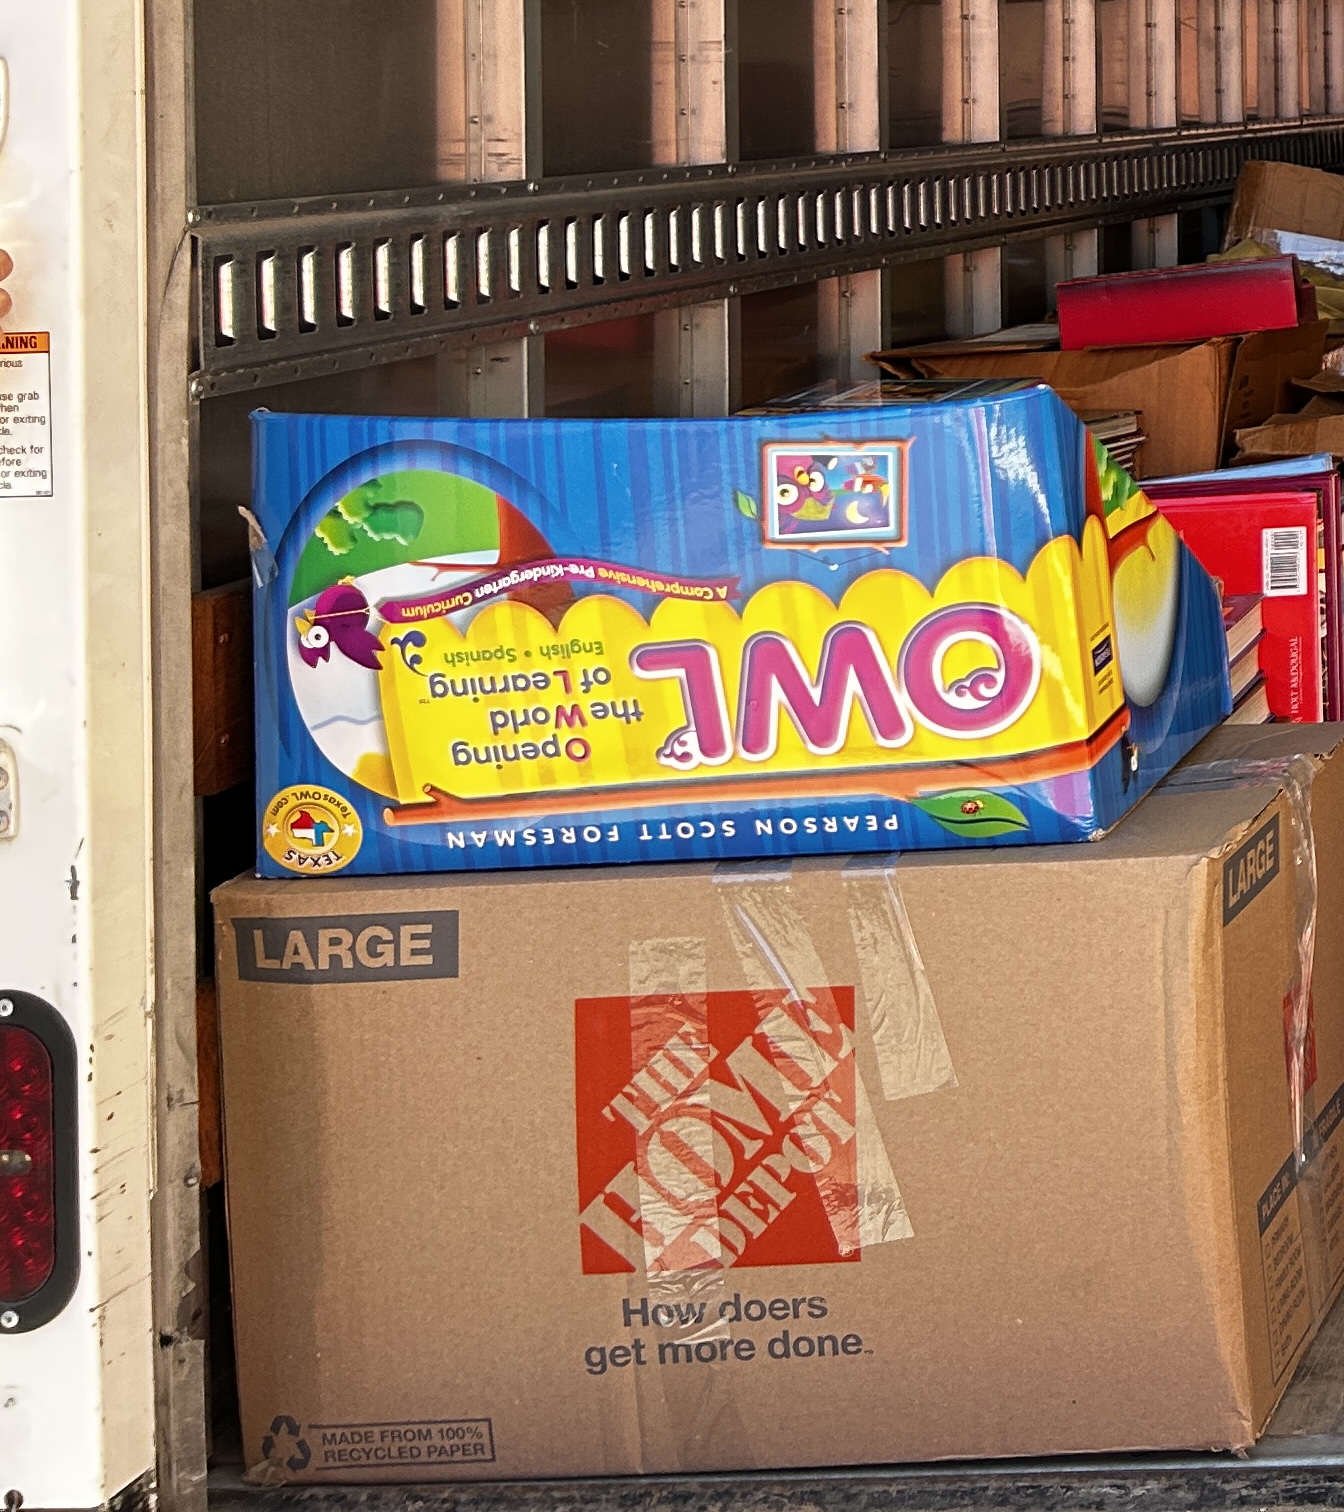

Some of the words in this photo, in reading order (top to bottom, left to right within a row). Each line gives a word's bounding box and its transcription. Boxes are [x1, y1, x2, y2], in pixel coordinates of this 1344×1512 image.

[18, 391, 39, 402] grab
[13, 415, 45, 425] exiting
[0, 445, 27, 454] check
[30, 445, 43, 454] for
[1, 470, 10, 478] or
[15, 469, 47, 479] exiting
[475, 562, 596, 599] Pre-Kindergarten
[597, 565, 713, 601] Comprehensive
[714, 584, 727, 600] A
[401, 592, 473, 619] Curriculum
[444, 647, 517, 664] Spanish
[539, 641, 604, 658] English
[580, 666, 611, 691] of
[630, 602, 1040, 770] OWL
[591, 698, 644, 725] the
[1290, 690, 1299, 715] HOLT
[489, 703, 587, 736] World
[451, 738, 591, 770] Opening
[271, 791, 351, 820] TexasOWL.com
[447, 824, 619, 850] FORESMAN
[640, 819, 736, 842] SCOTT
[756, 812, 899, 837] PEARSON
[284, 847, 343, 869] TEXAS
[1229, 829, 1274, 908] LARGE
[253, 924, 433, 970] LARGE
[601, 1020, 720, 1137] THE
[578, 987, 857, 1274] HOME
[689, 1088, 857, 1272] DEPOT
[622, 1298, 709, 1328] How
[720, 1292, 828, 1324] doers
[584, 1341, 646, 1375] get
[656, 1336, 756, 1365] more
[768, 1330, 865, 1361] done.
[322, 1430, 374, 1447] MADE
[380, 1428, 433, 1443] FROM
[436, 1426, 483, 1440] 100%
[324, 1446, 422, 1463] RECYCLED
[427, 1443, 485, 1458] PAPER
